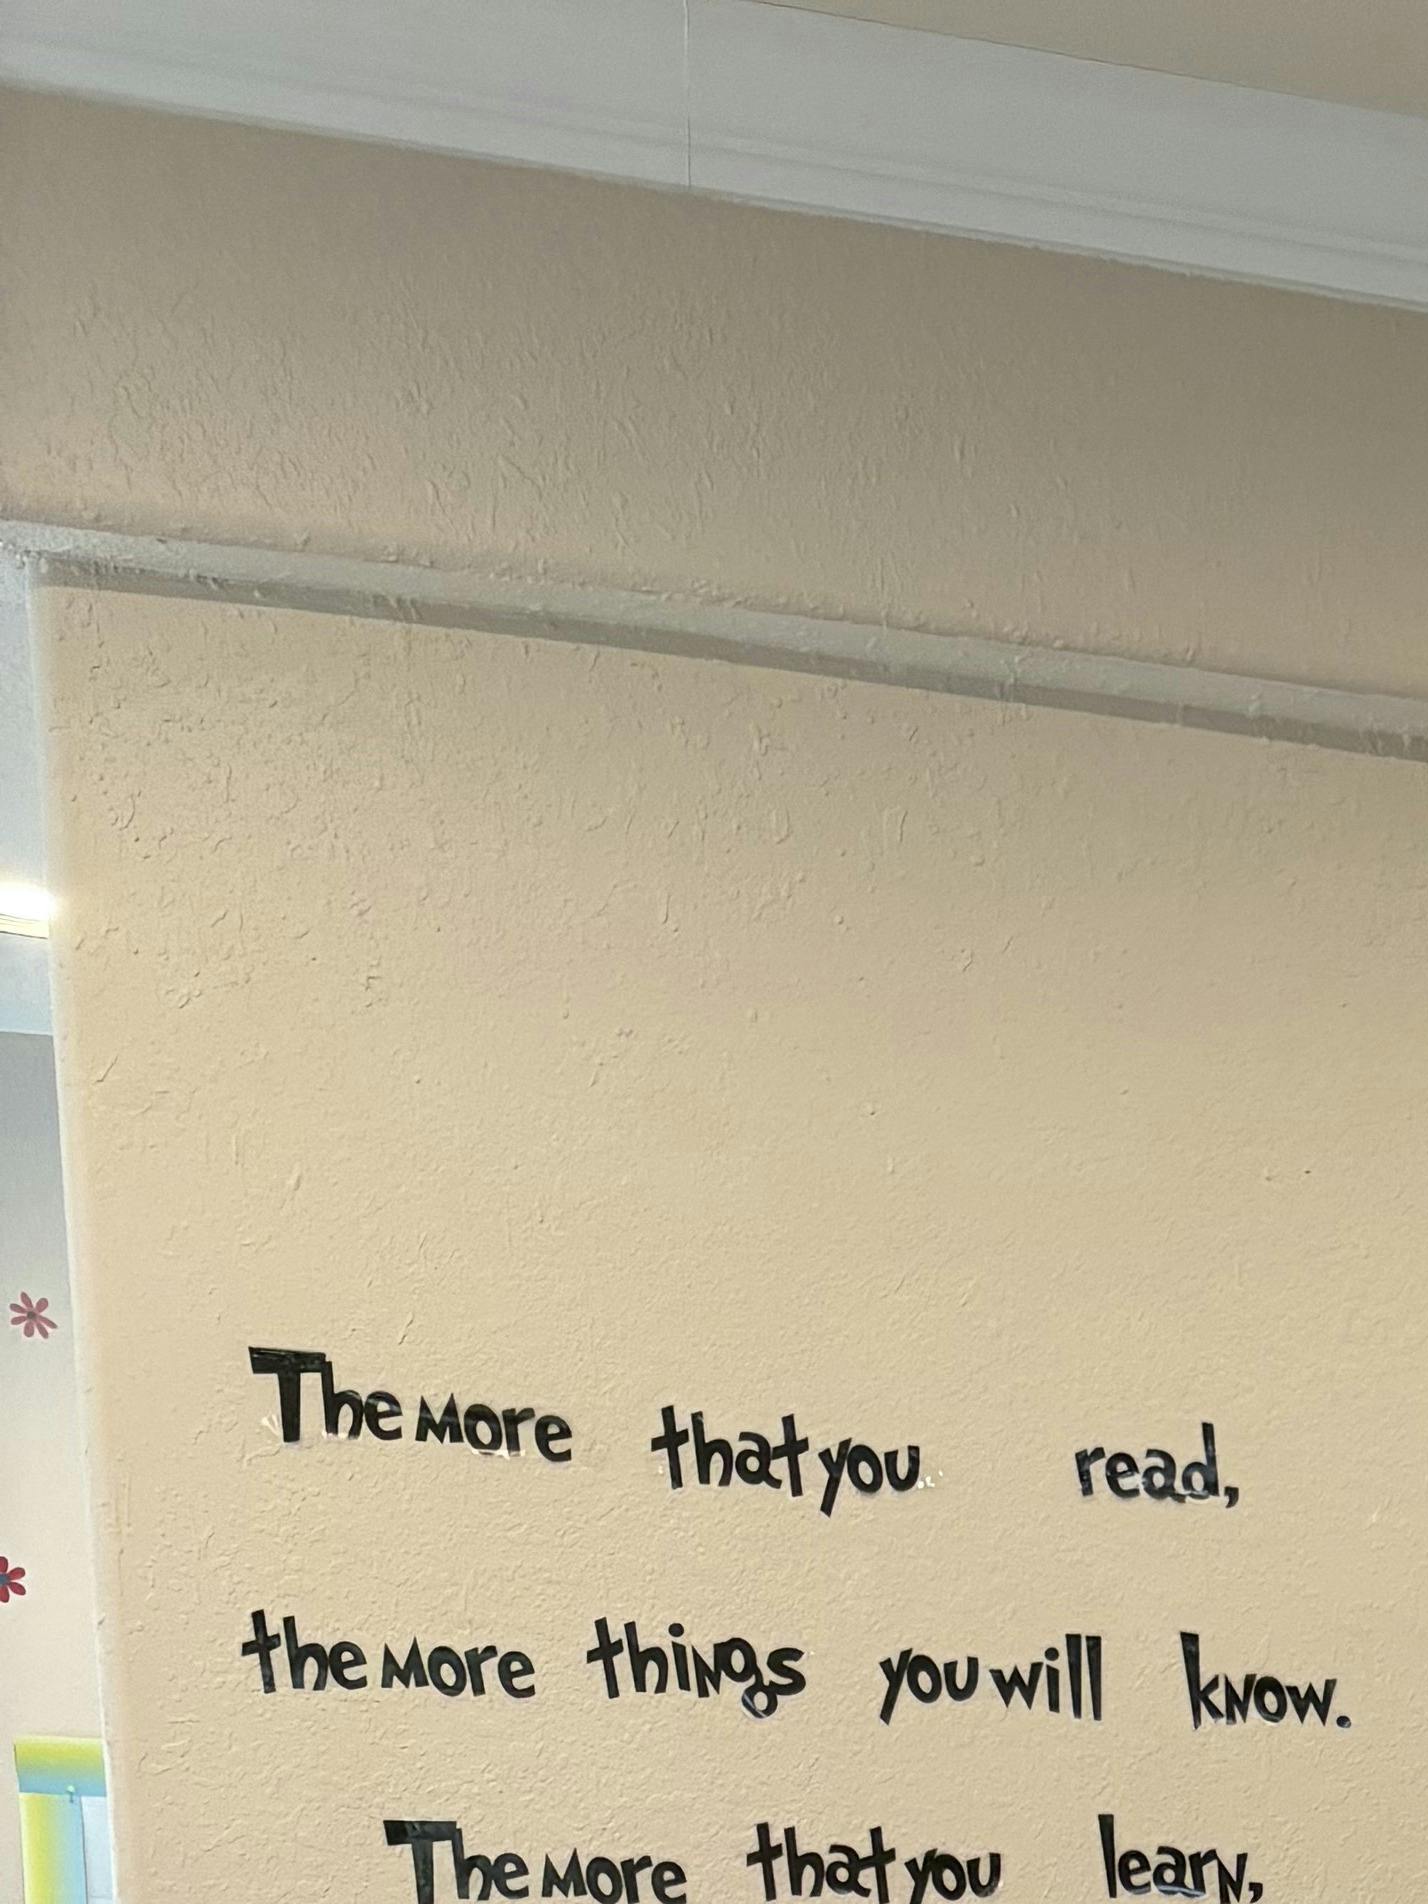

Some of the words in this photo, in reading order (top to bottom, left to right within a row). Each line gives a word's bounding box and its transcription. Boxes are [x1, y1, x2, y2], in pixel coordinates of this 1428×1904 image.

[249, 1347, 402, 1442] The
[652, 1406, 809, 1497] that
[819, 1438, 920, 1516] you
[1075, 1423, 1239, 1508] read,
[242, 1610, 367, 1693] the
[880, 1648, 978, 1724] you
[990, 1634, 1101, 1720] will
[747, 1823, 895, 1904] that
